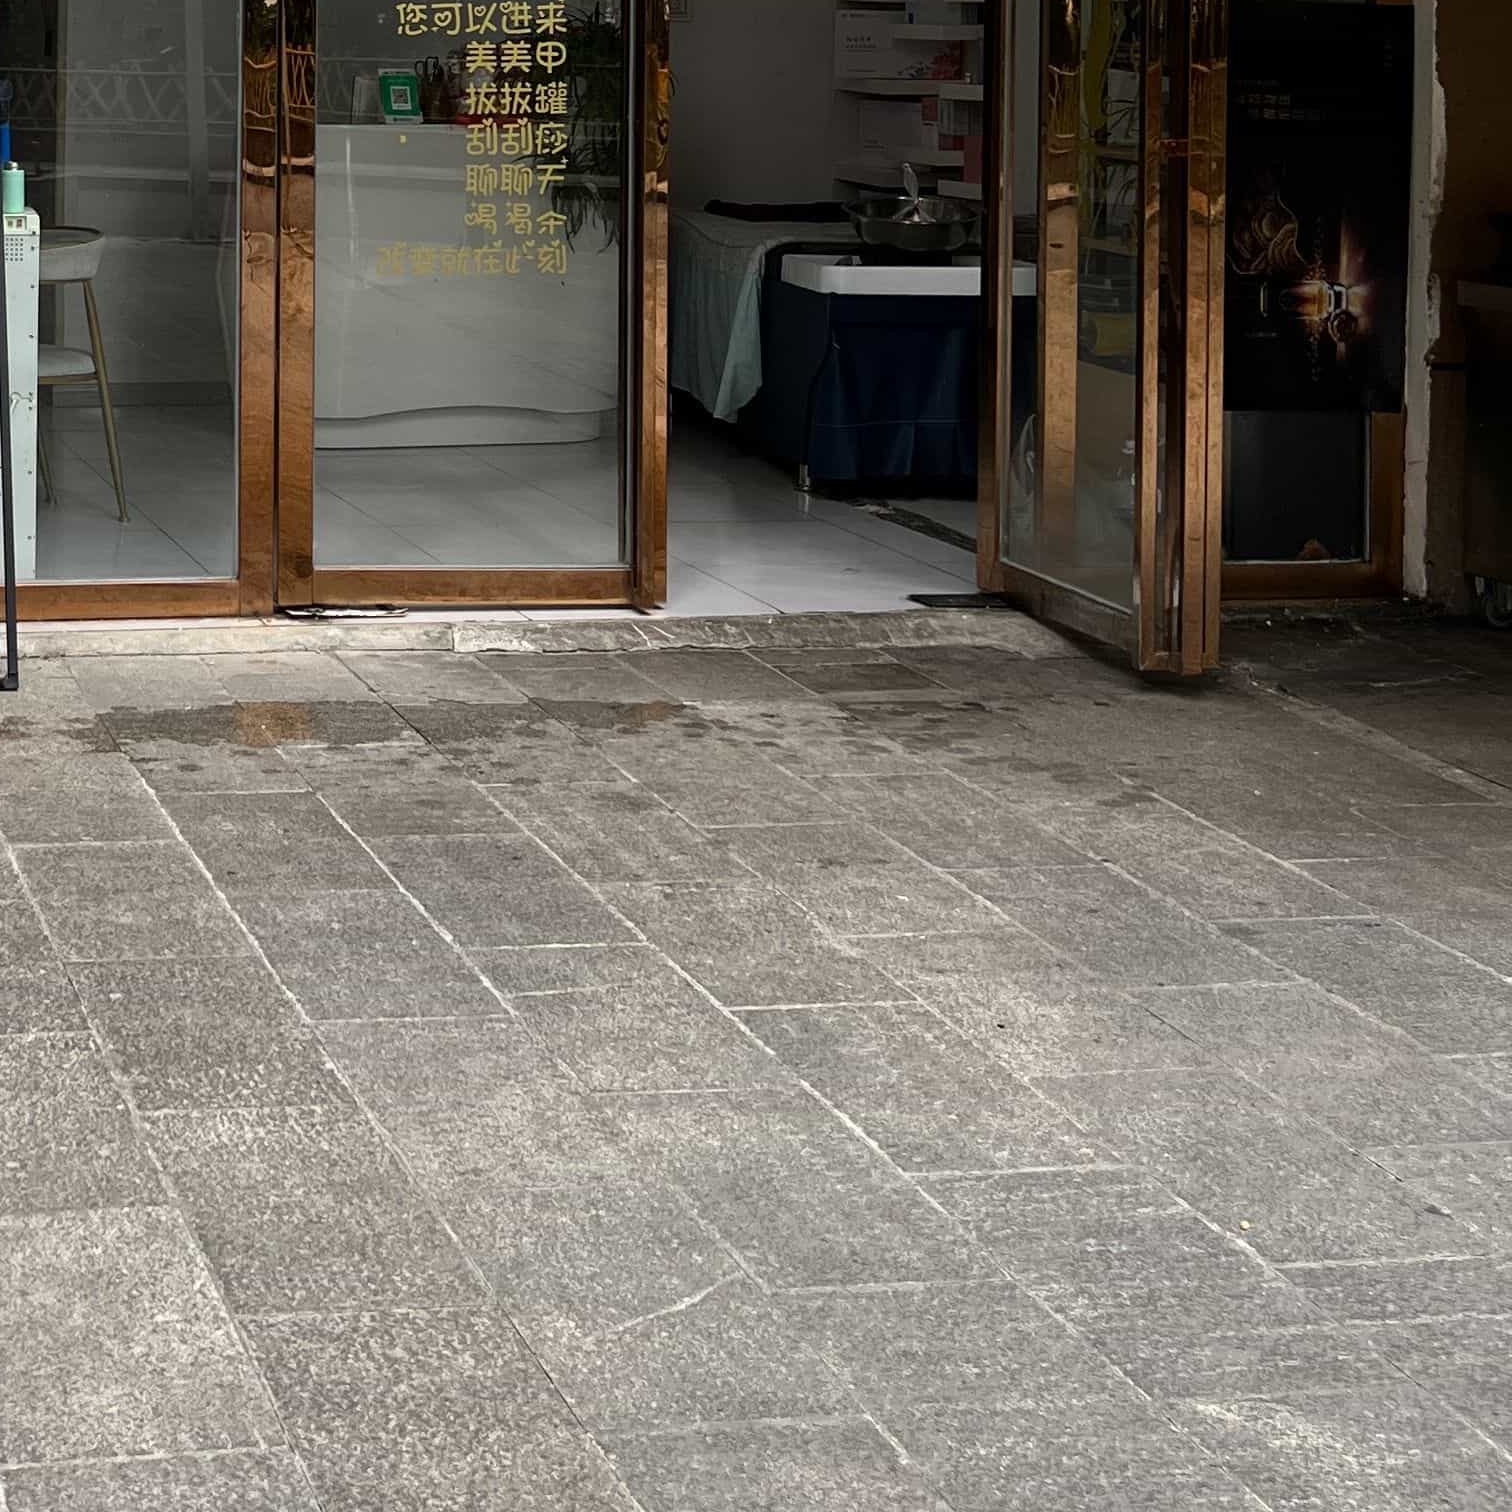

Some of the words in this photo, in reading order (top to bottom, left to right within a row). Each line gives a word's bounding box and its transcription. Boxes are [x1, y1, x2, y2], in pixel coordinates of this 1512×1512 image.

[396, 0, 568, 35] 您可以进来
[465, 40, 567, 74] 美美甲
[465, 82, 569, 115] 拔拔罐
[465, 118, 568, 155] 刮刮痧
